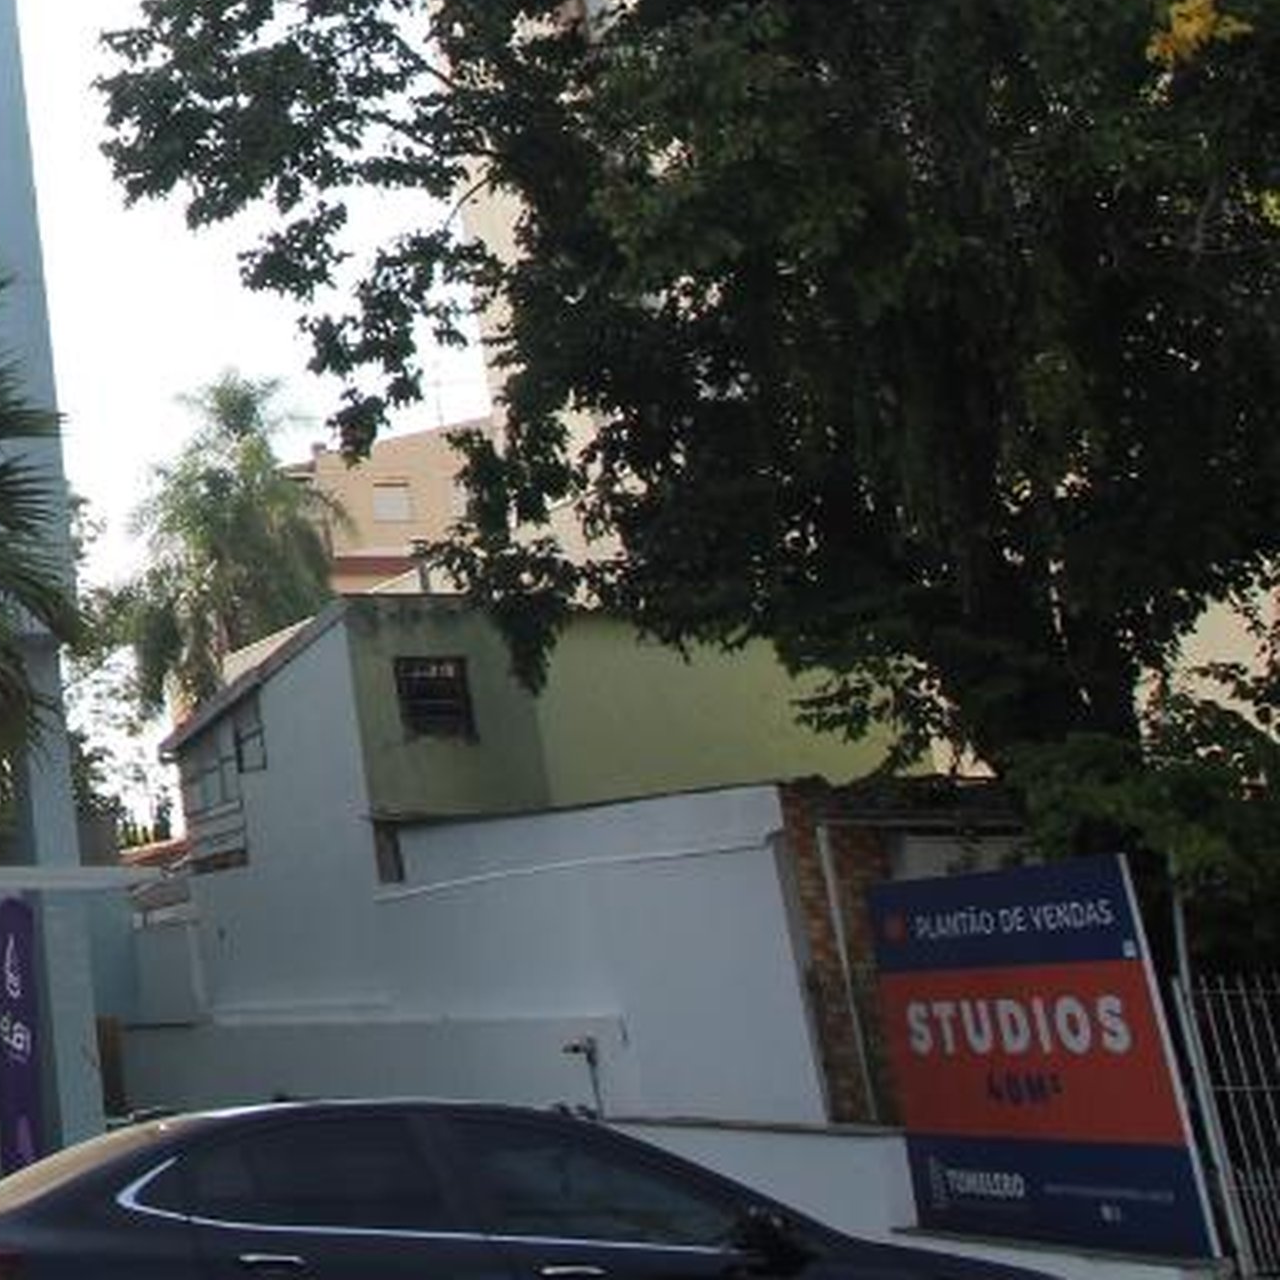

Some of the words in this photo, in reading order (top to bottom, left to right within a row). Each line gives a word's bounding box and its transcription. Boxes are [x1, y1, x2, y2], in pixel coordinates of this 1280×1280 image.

[915, 906, 994, 938] PLANTÃO
[998, 907, 1026, 932] DE
[1029, 900, 1115, 931] VENDAS
[907, 995, 1131, 1055] STUDIOS
